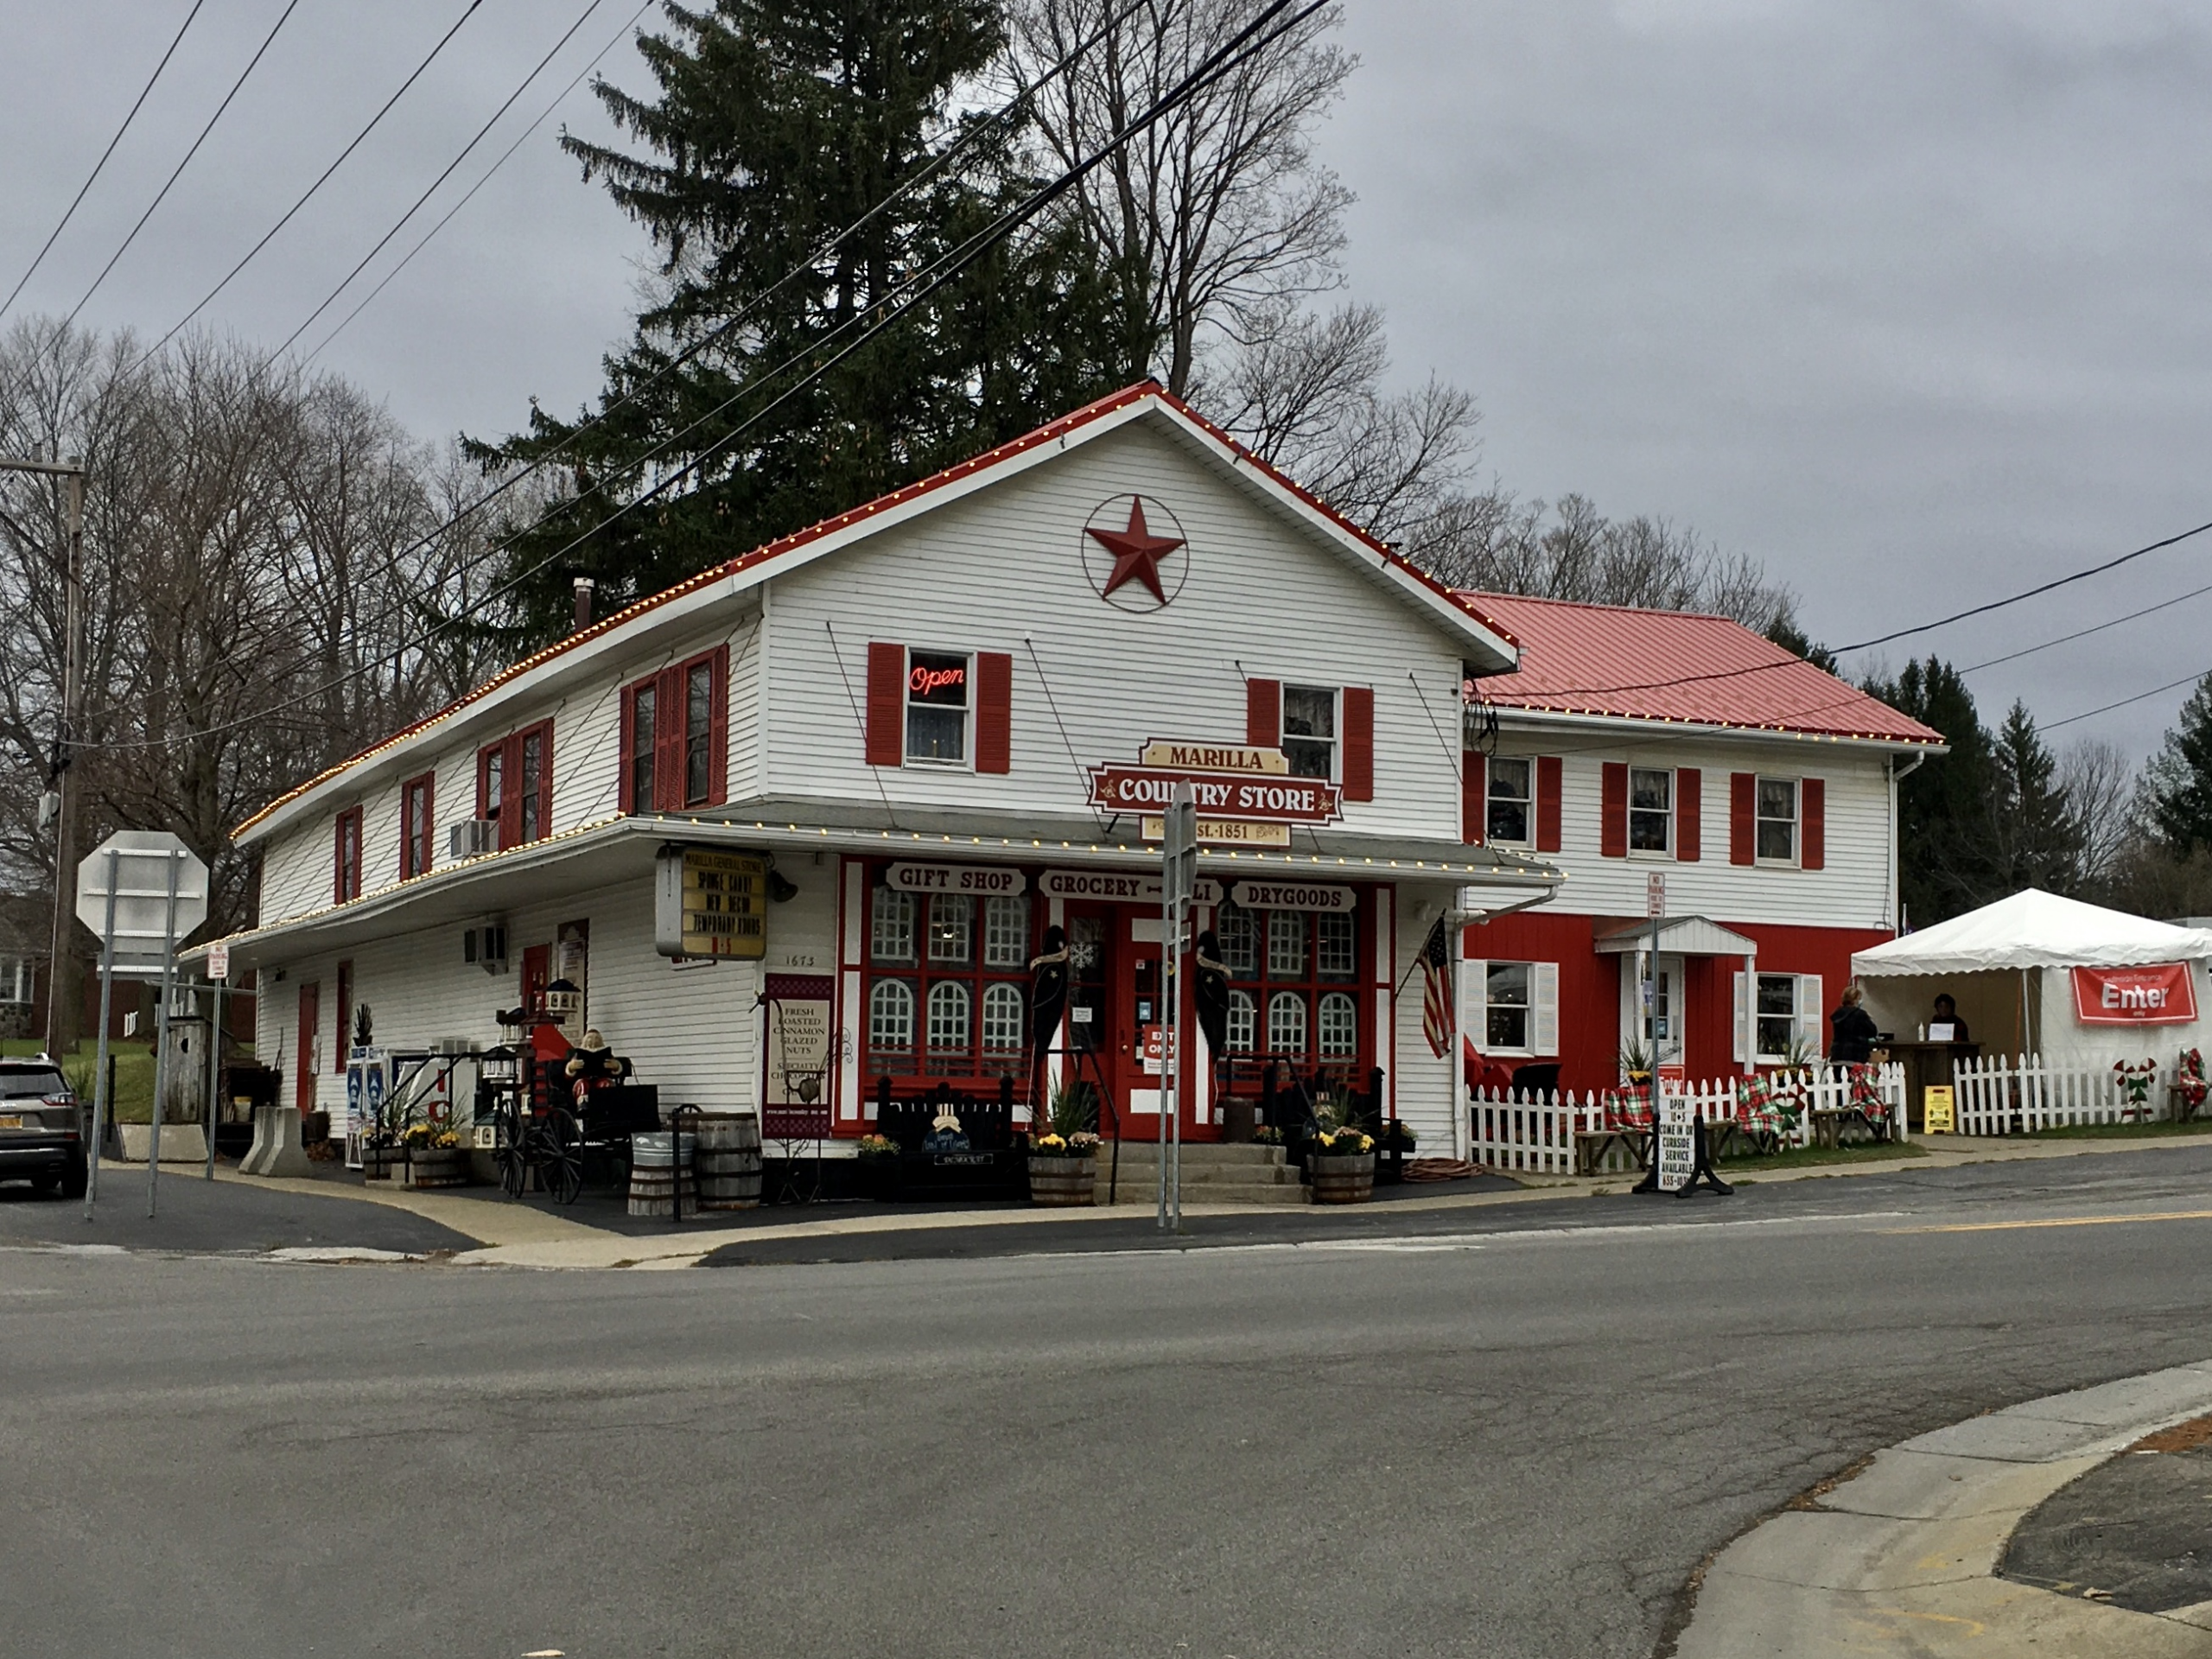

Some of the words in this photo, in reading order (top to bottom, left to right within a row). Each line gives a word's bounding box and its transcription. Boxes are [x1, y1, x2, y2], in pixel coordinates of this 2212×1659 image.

[909, 667, 964, 696] Open
[1169, 746, 1263, 770] MARILLA
[1238, 785, 1315, 811] STORE
[1197, 823, 1214, 838] st.
[1217, 824, 1248, 839] 1851
[685, 853, 712, 867] MARILLA
[713, 855, 741, 870] GENERAL
[741, 860, 761, 874] STORE
[899, 868, 950, 887] GIFT
[960, 871, 1013, 891] SHOP
[1050, 875, 1141, 897] GROCERY
[1192, 884, 1211, 901] LI
[1248, 887, 1342, 907] DRYGOODS
[786, 955, 815, 966] 1673
[2101, 982, 2170, 1008] Enter
[785, 1007, 814, 1016] FRESH
[1152, 1031, 1175, 1041] EXT
[1148, 1044, 1175, 1053] ONY
[1669, 1098, 1685, 1110] OPEN
[1659, 1124, 1675, 1135] COME
[1676, 1124, 1683, 1135] IN
[1686, 1124, 1694, 1136] OR
[1662, 1137, 1690, 1148] CURBSIDE
[1665, 1150, 1689, 1161] SERVICE
[1662, 1163, 1694, 1173] AVAILABLE
